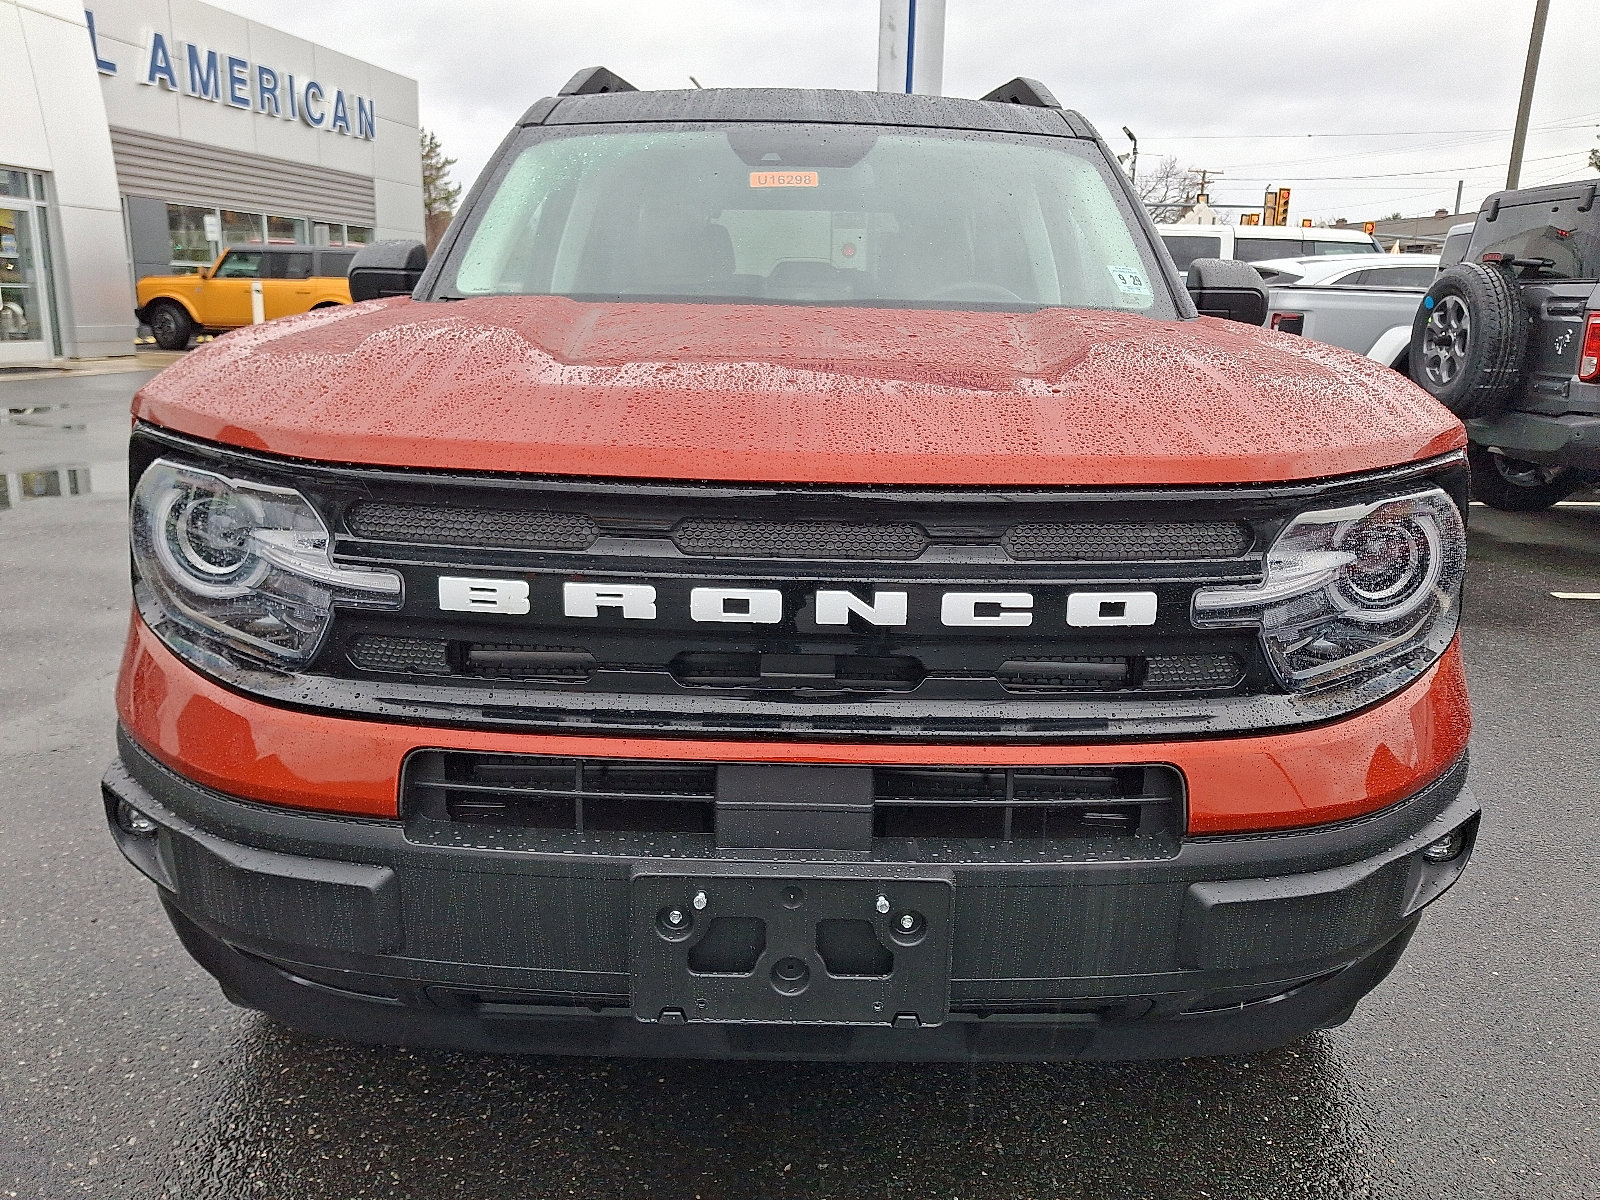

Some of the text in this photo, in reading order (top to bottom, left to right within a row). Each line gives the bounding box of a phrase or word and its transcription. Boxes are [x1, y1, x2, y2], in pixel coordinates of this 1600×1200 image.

[146, 31, 376, 141] AMERICAN
[757, 175, 812, 185] U16298
[1118, 274, 1127, 285] 9
[438, 575, 1159, 627] BRONCO
